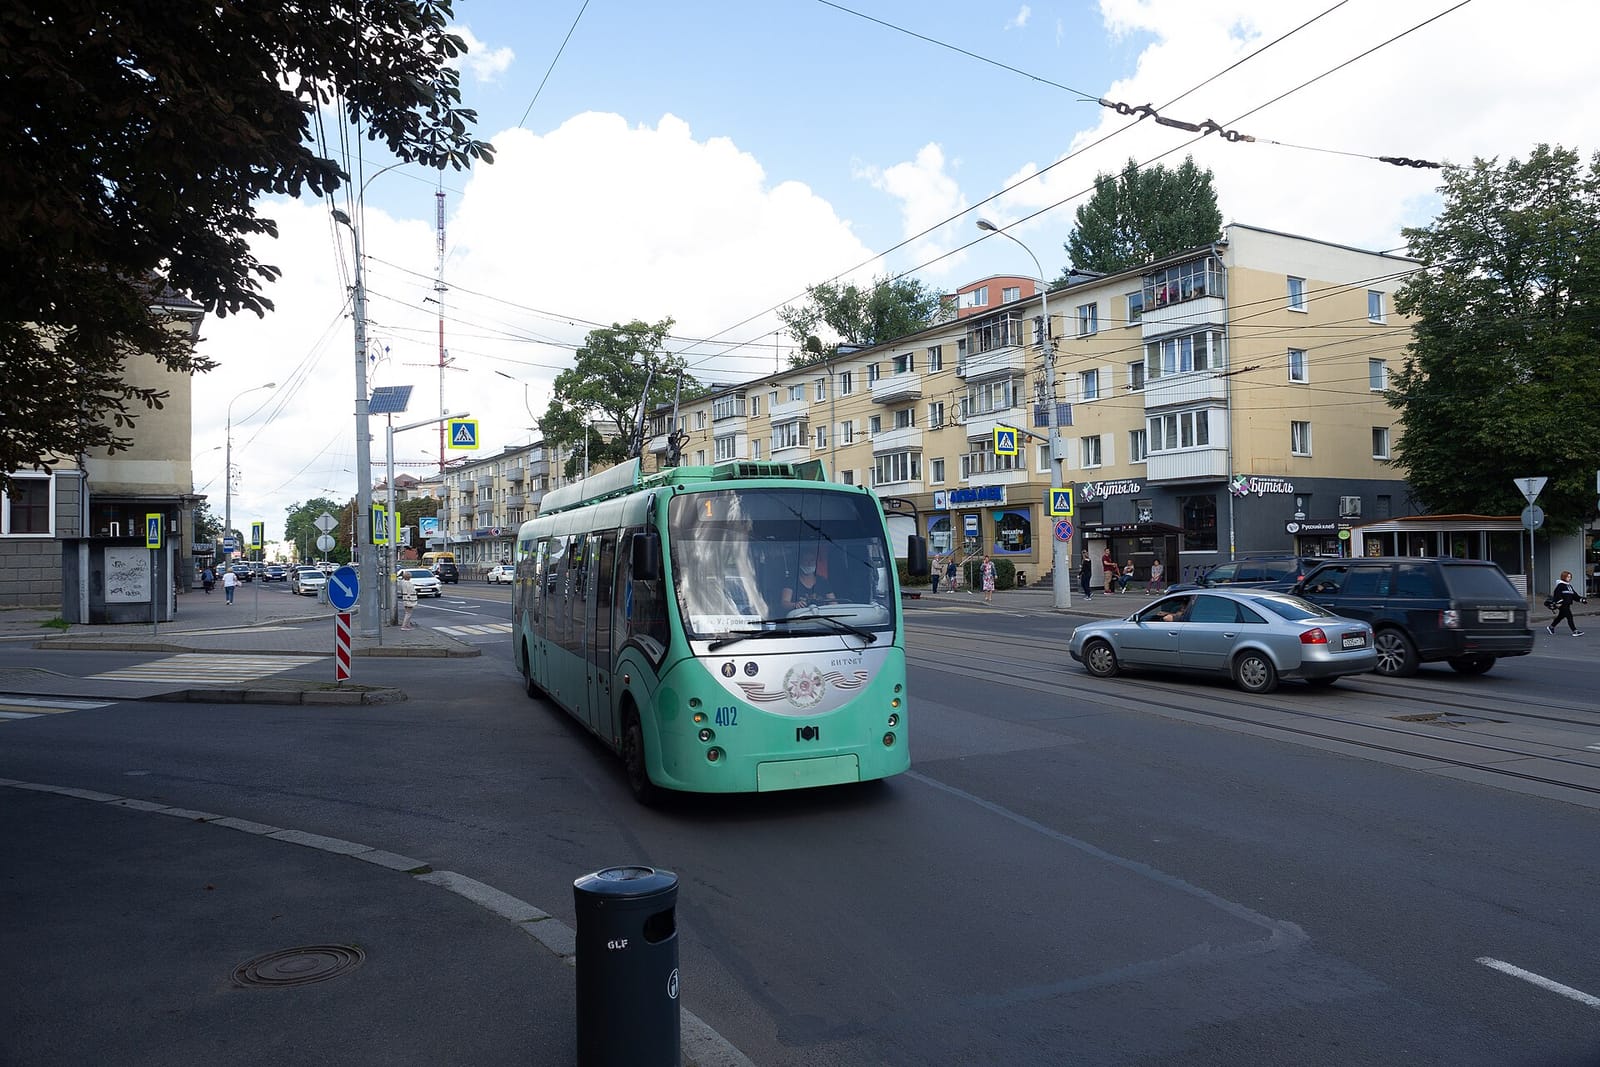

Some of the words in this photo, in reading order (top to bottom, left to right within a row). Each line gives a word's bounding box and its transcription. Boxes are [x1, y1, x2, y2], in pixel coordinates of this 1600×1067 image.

[1095, 482, 1140, 499] Бутыль
[1250, 477, 1294, 497] Бутыль
[704, 499, 713, 517] 1
[715, 706, 738, 727] 402
[607, 938, 628, 950] GLF
